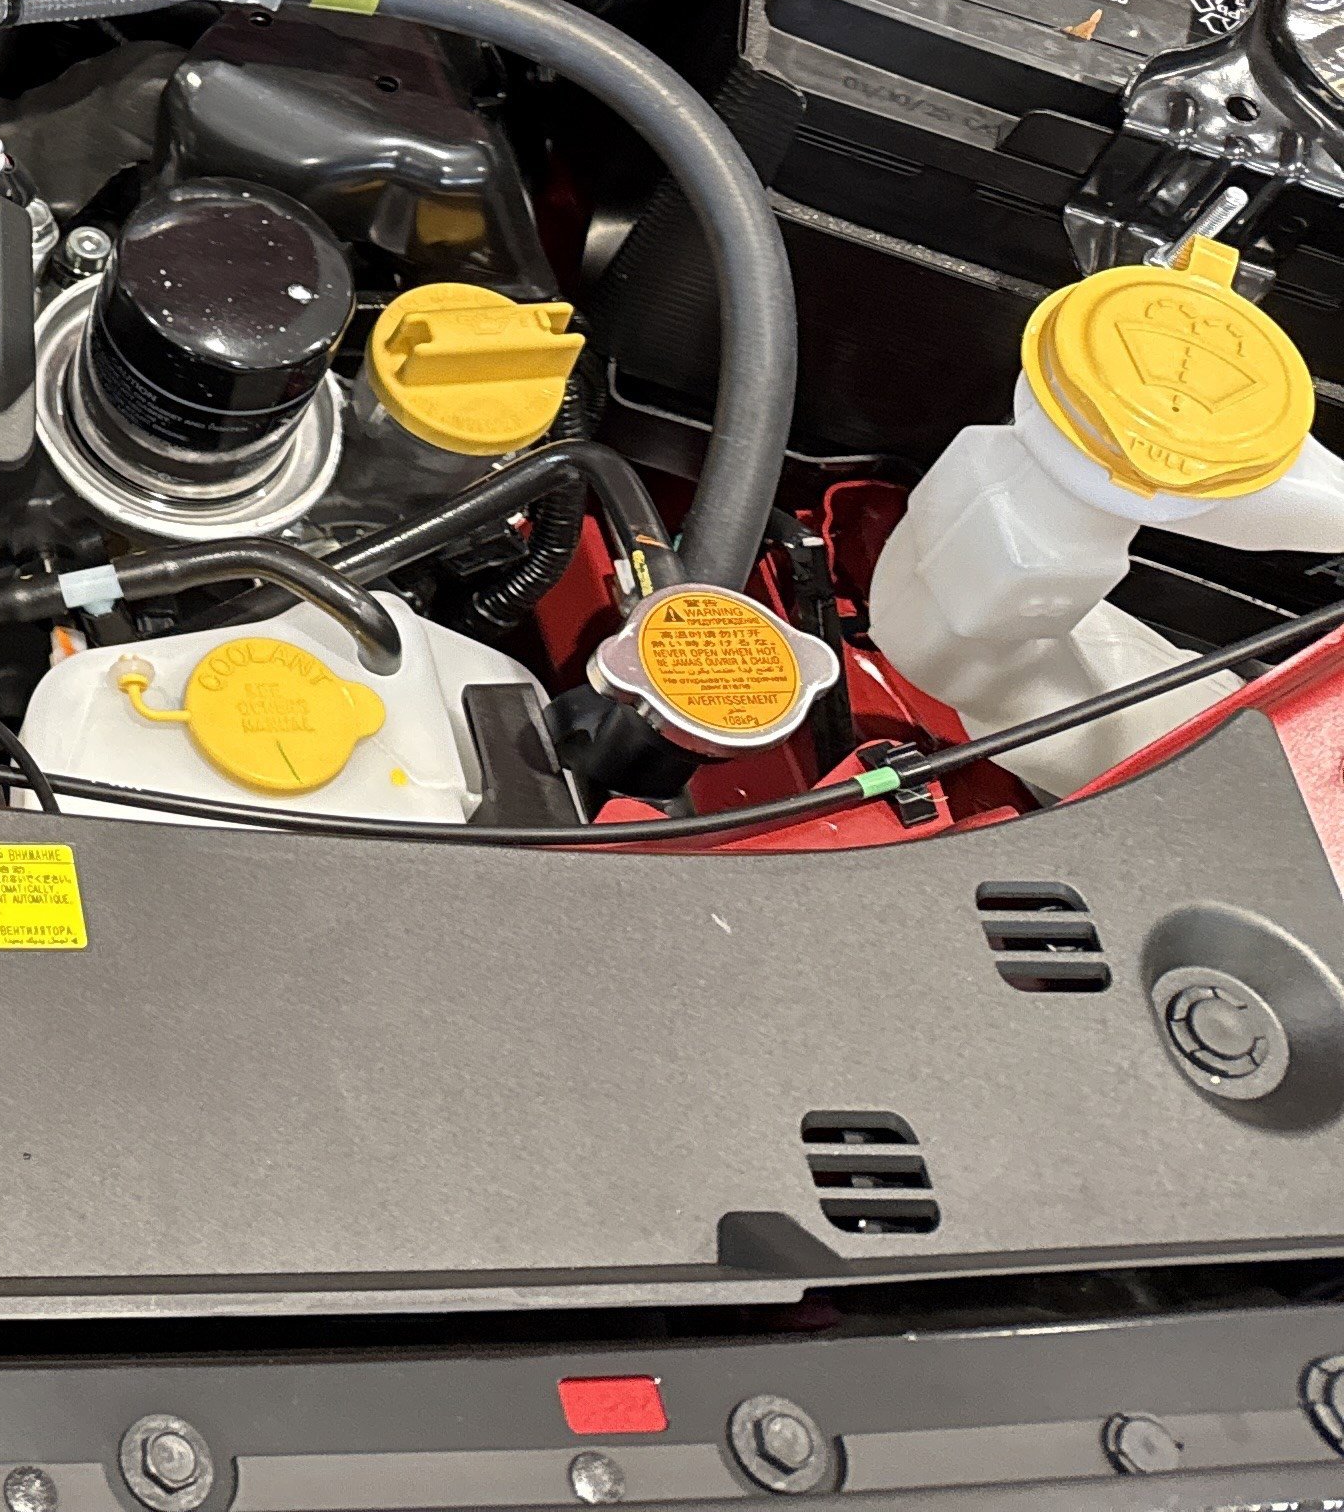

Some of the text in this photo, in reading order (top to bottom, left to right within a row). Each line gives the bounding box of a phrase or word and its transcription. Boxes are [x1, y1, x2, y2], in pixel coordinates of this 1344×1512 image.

[1217, 5, 1240, 20] Pb
[1130, 437, 1192, 476] PULL
[684, 608, 743, 618] WARNING
[653, 649, 687, 658] NEVER
[691, 649, 718, 658] OPEN
[721, 648, 752, 657] WHEN
[198, 643, 333, 692] COOLANT
[672, 658, 703, 667] JAMAIS
[705, 657, 738, 666] OUVRIR
[687, 694, 778, 705] AVERTISSEMENT
[8, 849, 62, 862] ВНИМАНИЕ
